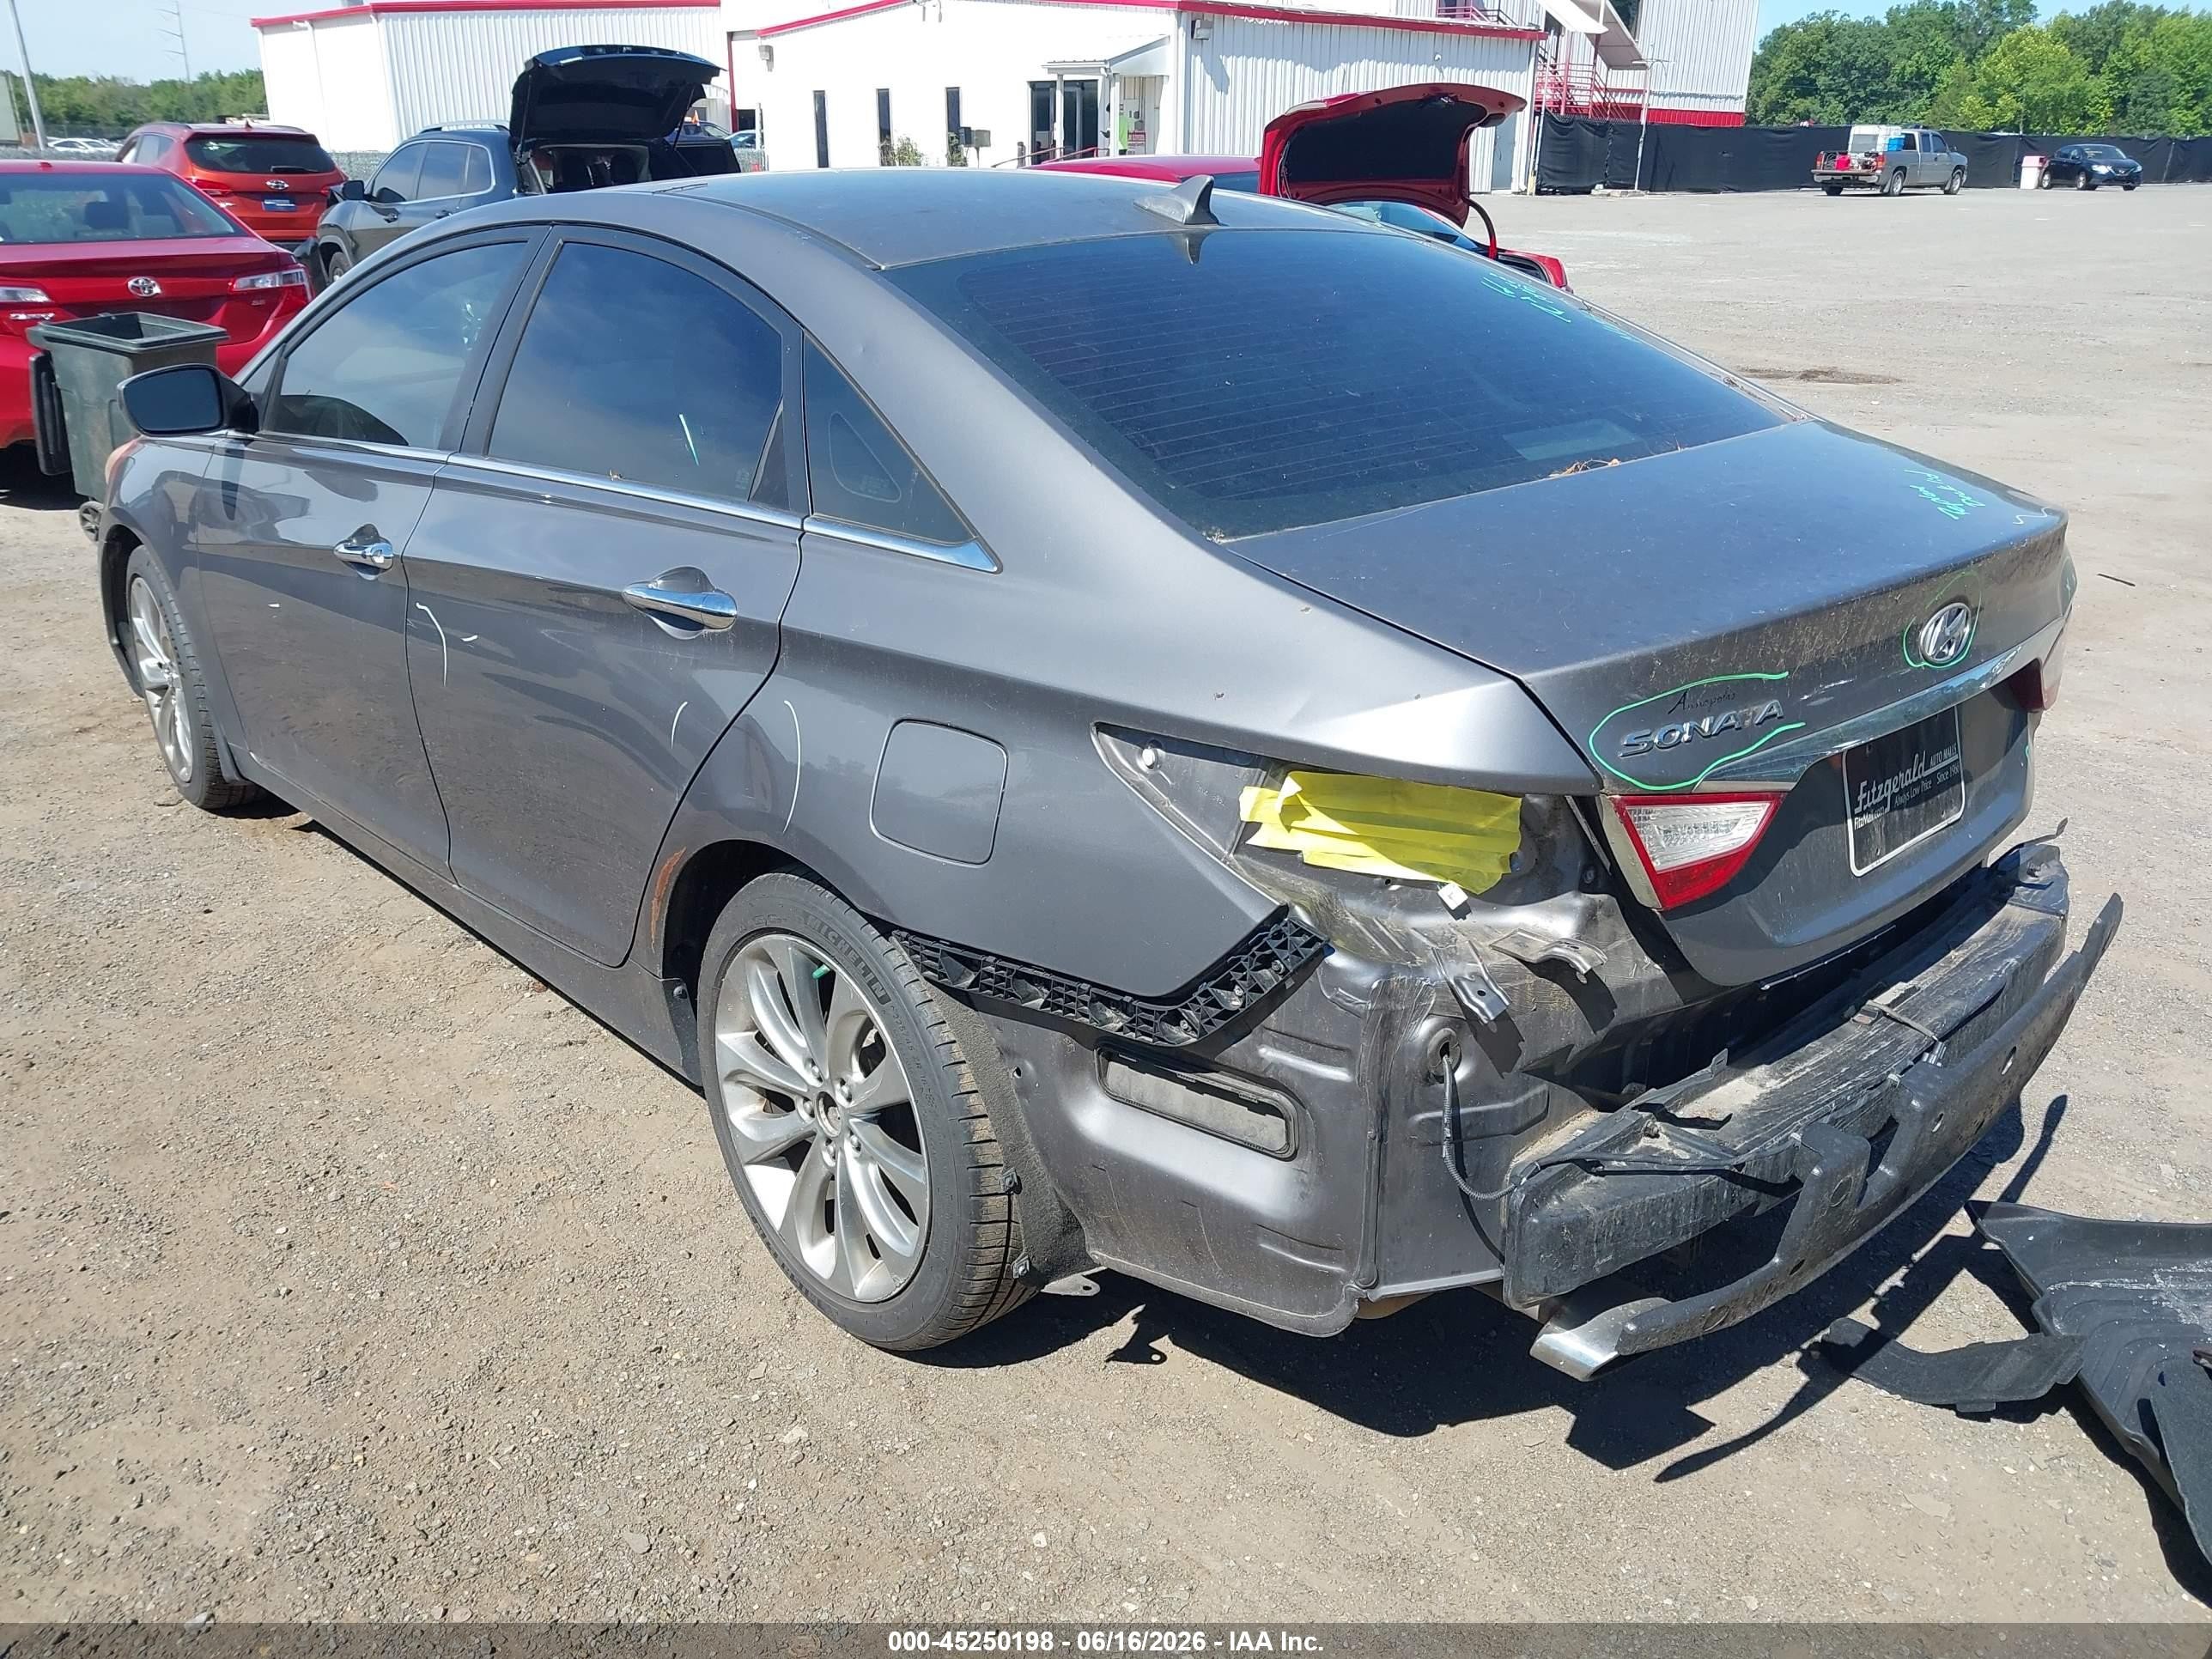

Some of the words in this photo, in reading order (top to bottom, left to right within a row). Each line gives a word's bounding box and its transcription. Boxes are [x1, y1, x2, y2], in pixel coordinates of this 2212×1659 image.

[1929, 750, 1943, 767] AUTO
[1942, 743, 1957, 761] MALLS
[1854, 750, 1927, 814] Fitzgerald
[1894, 792, 1910, 808] Always
[1910, 785, 1921, 799] Low
[1921, 779, 1932, 793] Price
[1936, 770, 1949, 785] Since
[1854, 805, 1886, 830] FitzMall.com
[804, 914, 888, 1000] MICHELIN
